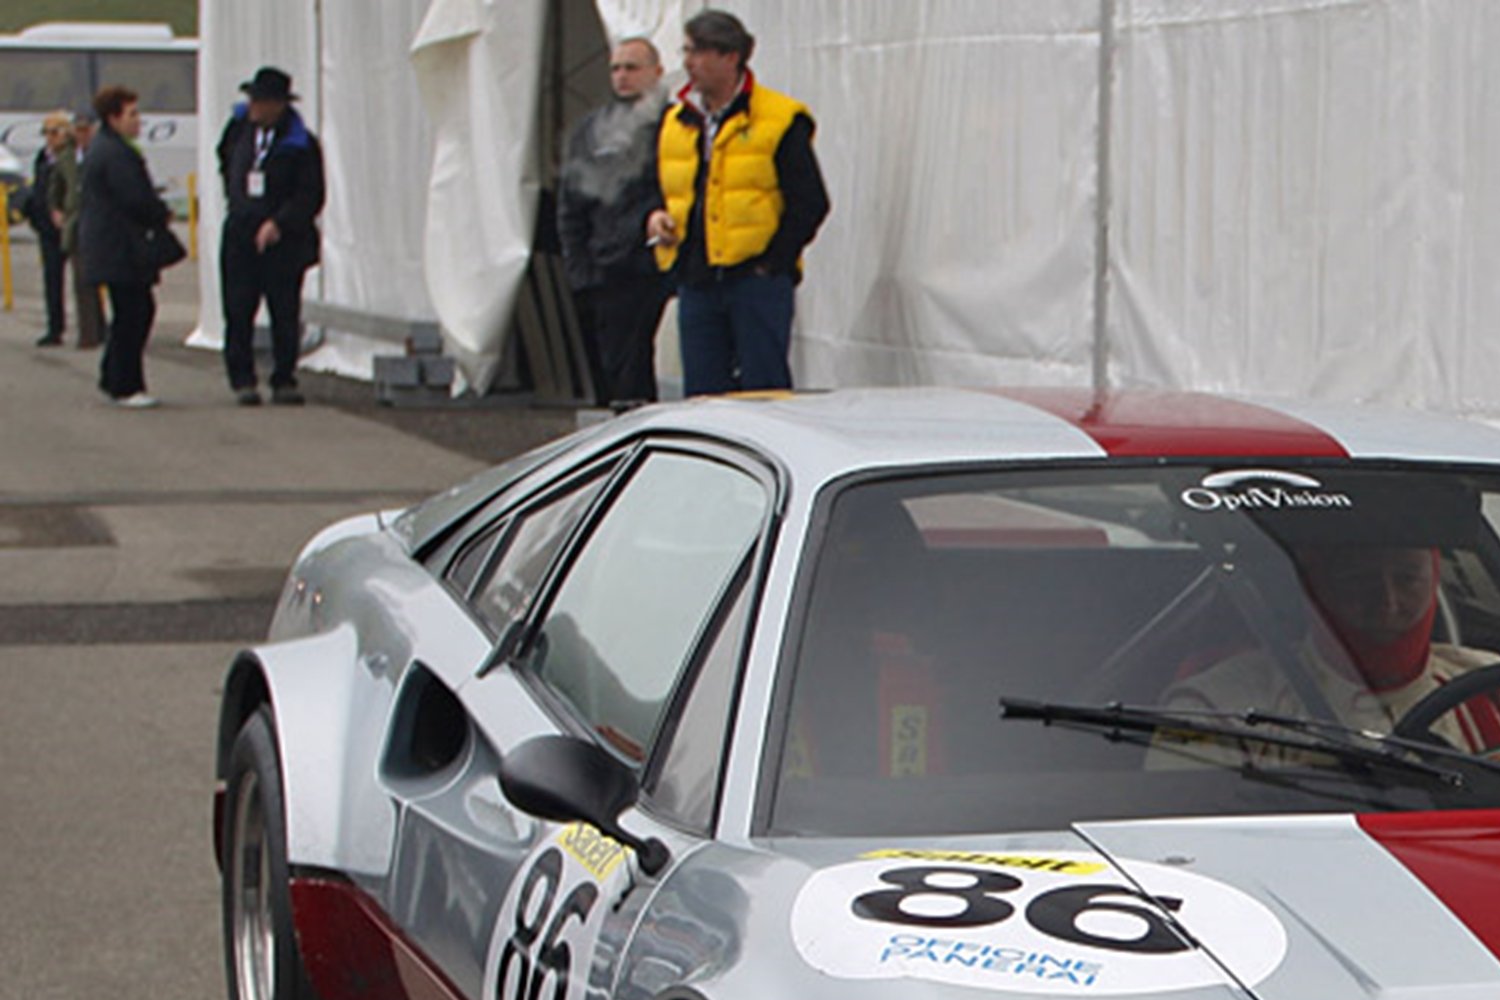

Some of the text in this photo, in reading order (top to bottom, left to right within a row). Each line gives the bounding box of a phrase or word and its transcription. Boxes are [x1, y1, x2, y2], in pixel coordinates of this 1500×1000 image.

[1181, 487, 1352, 511] OptiVision
[851, 866, 1200, 956] 86
[880, 947, 1096, 986] PANERAI
[889, 934, 1103, 971] OFFICINE
